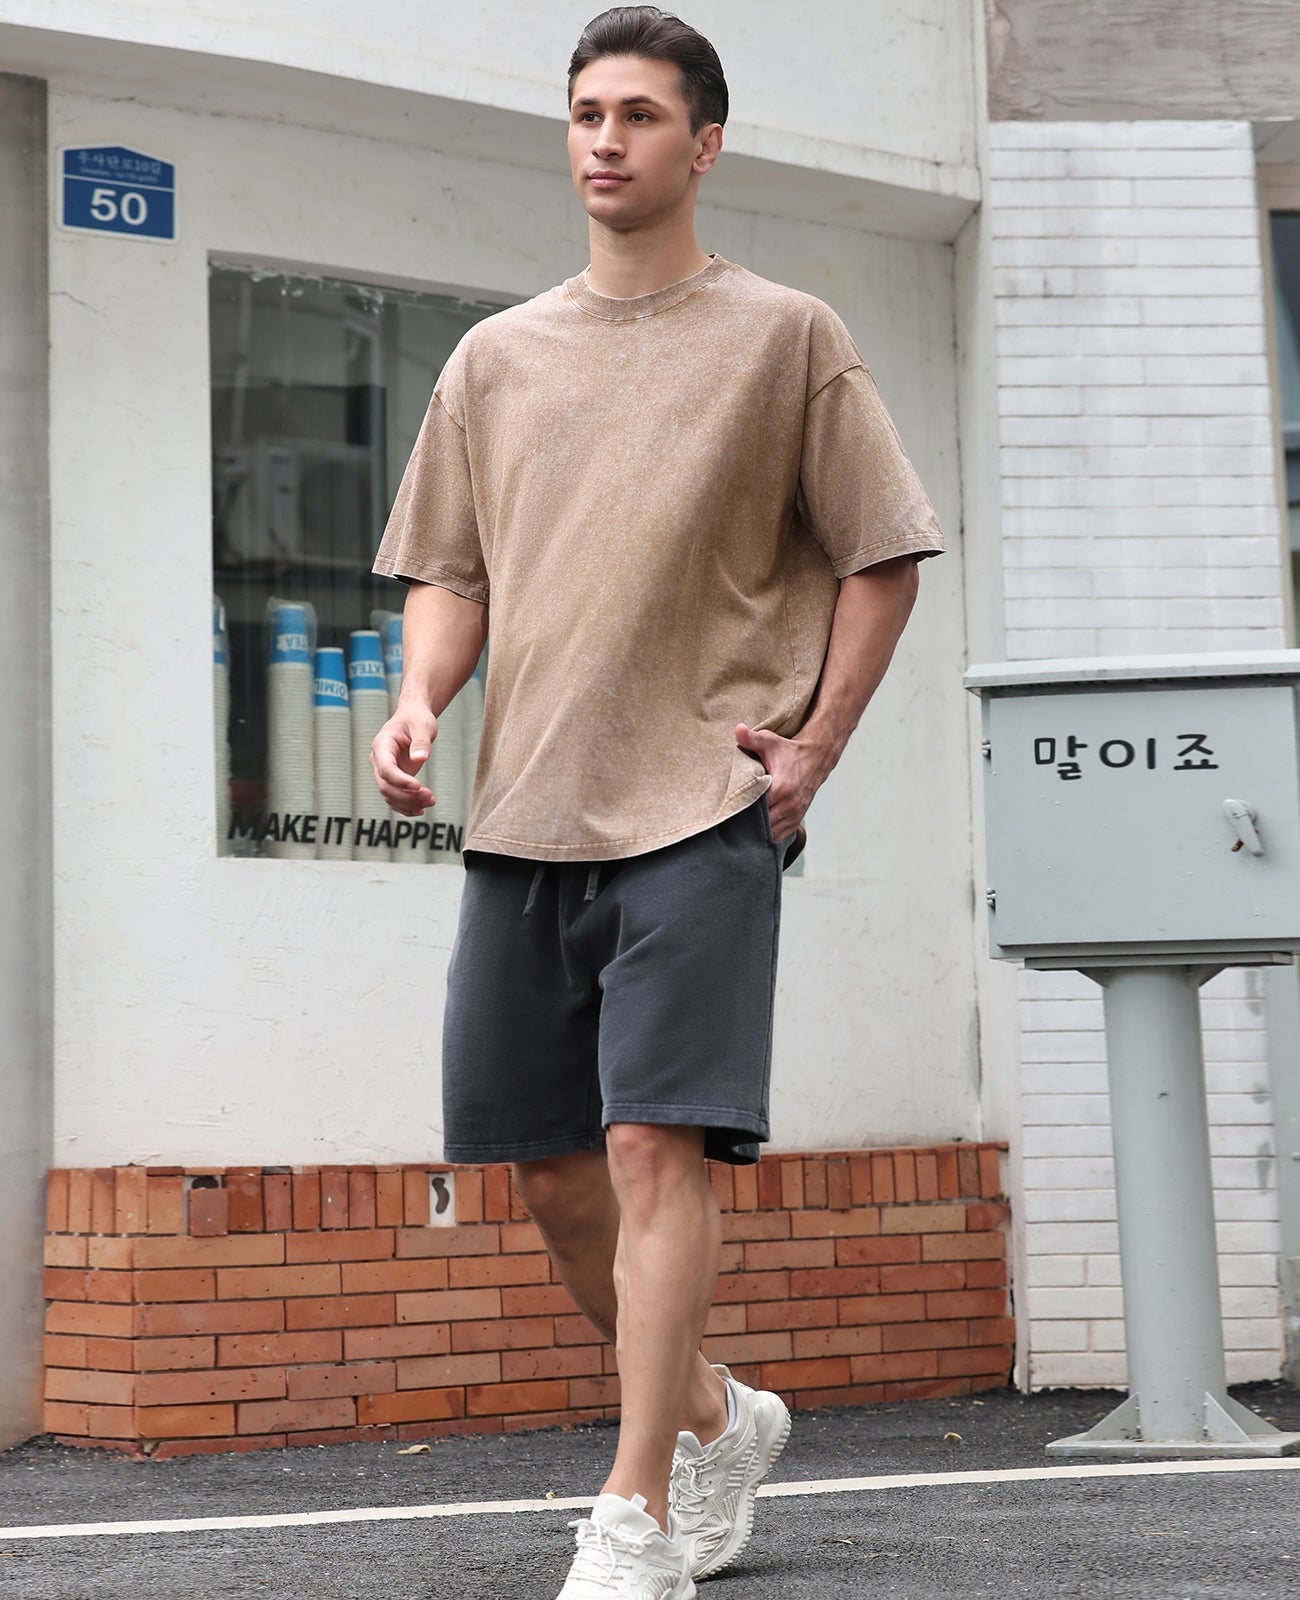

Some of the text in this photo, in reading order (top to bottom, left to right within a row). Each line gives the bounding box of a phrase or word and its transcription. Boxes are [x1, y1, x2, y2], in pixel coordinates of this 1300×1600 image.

[90, 188, 147, 225] 50
[1033, 733, 1219, 780] 말이죠
[228, 812, 463, 853] MAKE IT HAPPEN
